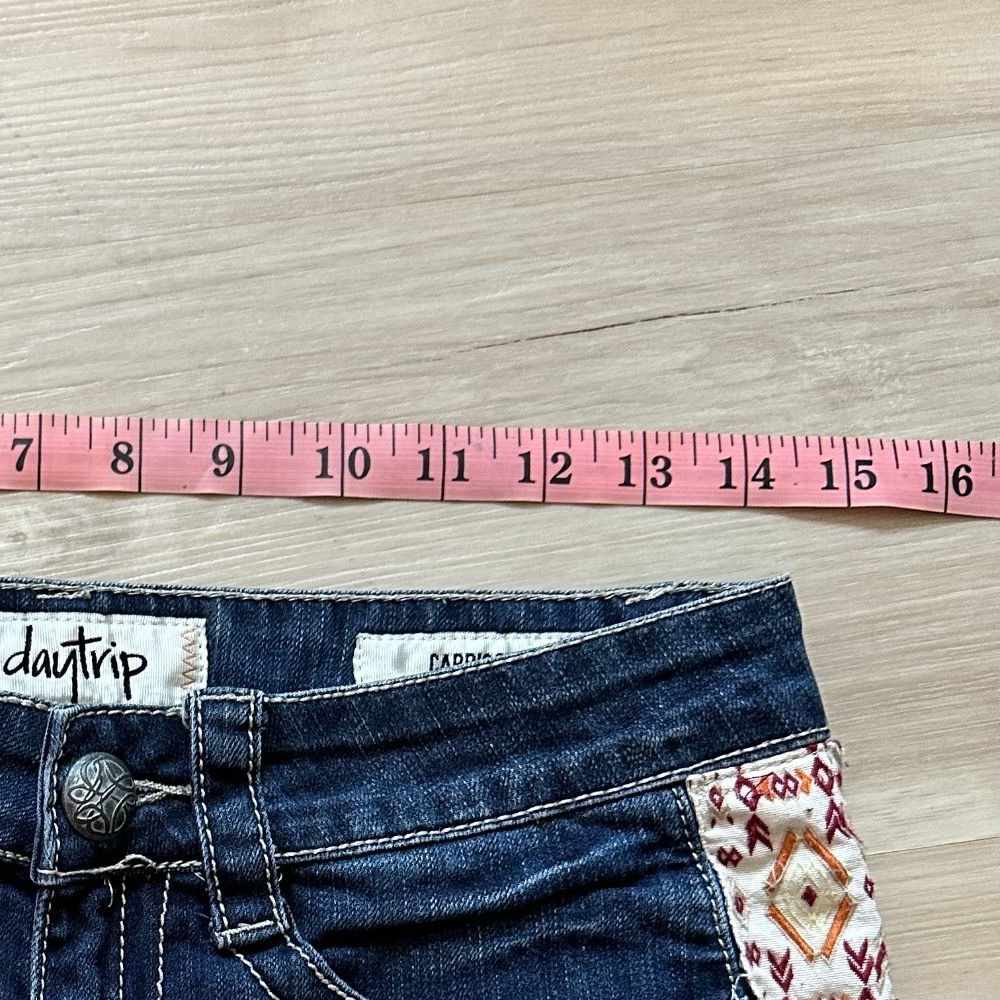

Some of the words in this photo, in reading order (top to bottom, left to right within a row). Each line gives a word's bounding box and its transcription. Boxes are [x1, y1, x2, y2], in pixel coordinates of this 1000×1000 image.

[10, 437, 34, 472] 7
[110, 441, 134, 475] 8
[211, 443, 236, 478] 9
[315, 446, 371, 480] 10
[416, 448, 470, 482] 11
[517, 450, 573, 485] 12
[618, 454, 673, 488] 13
[718, 456, 776, 490] 14
[820, 458, 877, 491] 15
[921, 461, 974, 497] 16
[3, 625, 148, 703] daytrip
